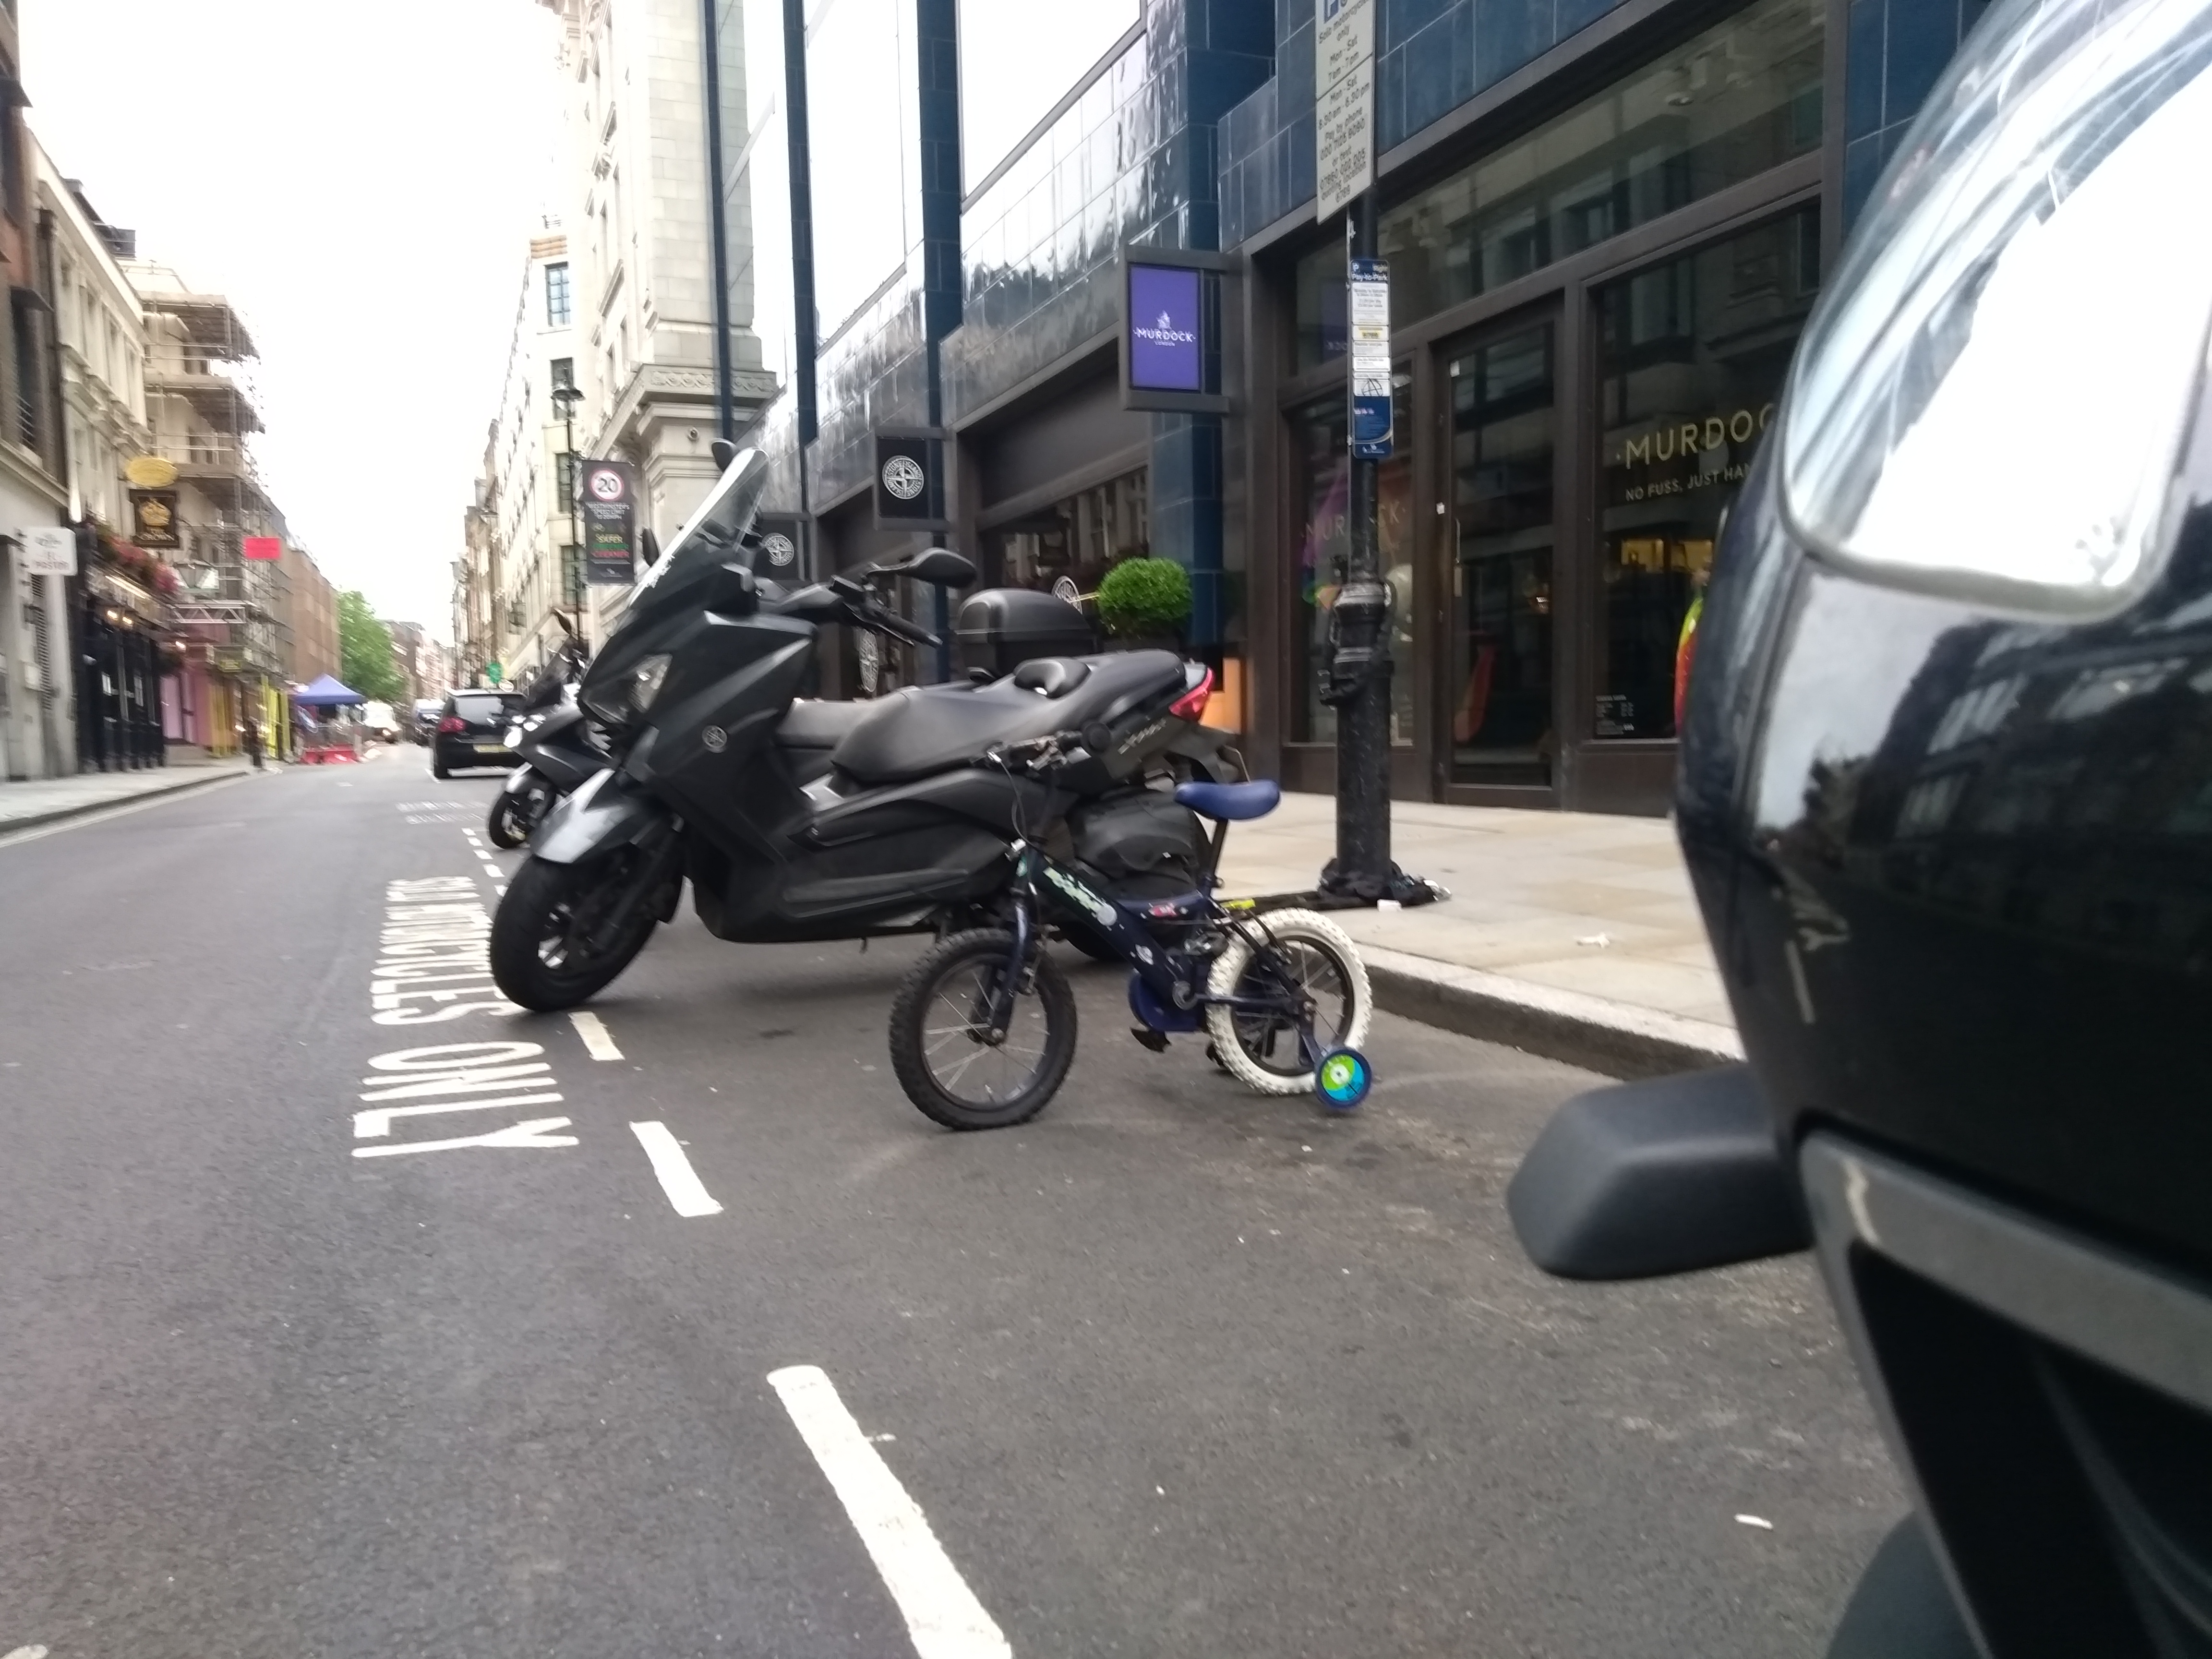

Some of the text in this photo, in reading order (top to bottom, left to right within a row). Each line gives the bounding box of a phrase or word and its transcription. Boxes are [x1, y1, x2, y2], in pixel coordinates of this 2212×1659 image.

[1330, 50, 1343, 66] Mon
[1347, 35, 1358, 51] Sat
[1330, 89, 1343, 105] Mon
[1347, 74, 1358, 90] Sat
[1325, 107, 1362, 143] Pay by phone
[1136, 327, 1193, 343] MURDOCK
[597, 477, 618, 493] 20
[1625, 486, 1644, 501] NO
[1648, 479, 1683, 498] FUSS,
[1687, 470, 1719, 489] JUST
[595, 534, 623, 543] SAFER
[351, 1041, 579, 1158] ONLY
